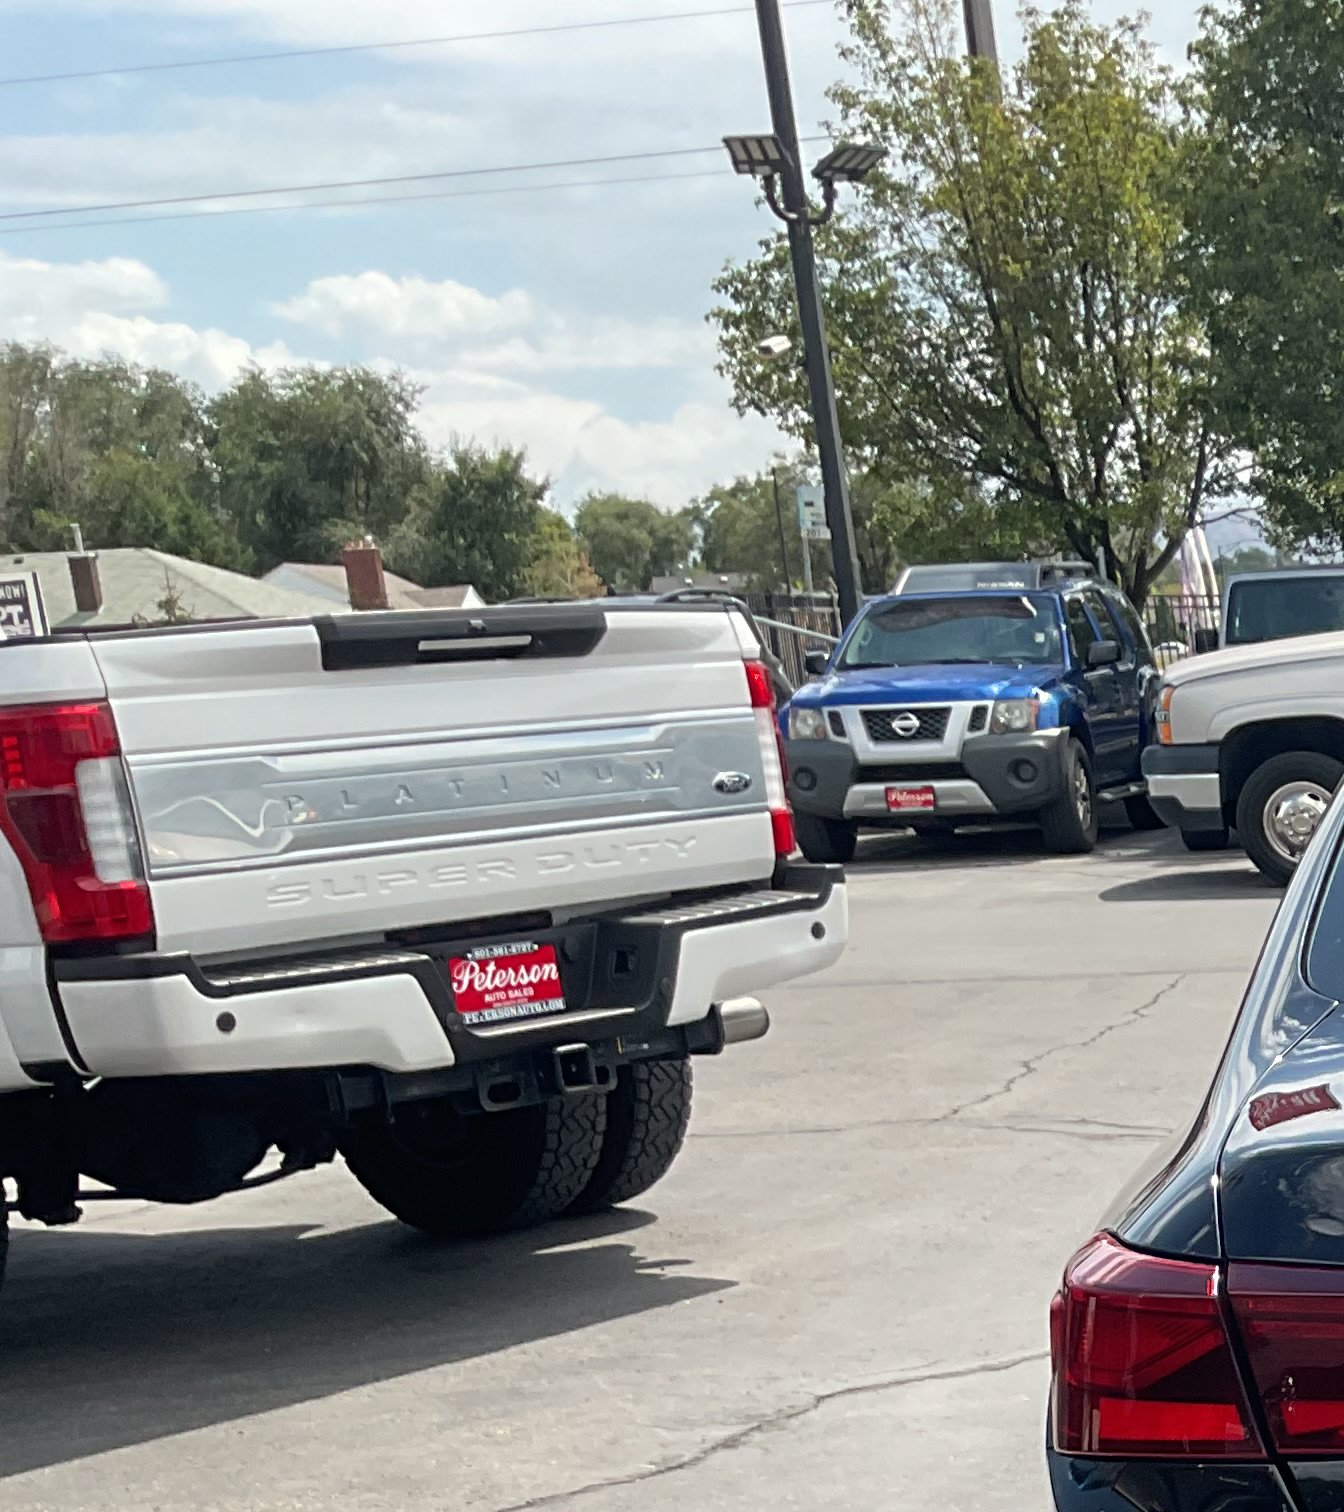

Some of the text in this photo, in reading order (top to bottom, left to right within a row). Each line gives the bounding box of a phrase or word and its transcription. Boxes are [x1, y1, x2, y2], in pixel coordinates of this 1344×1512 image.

[283, 760, 664, 811] PLATINUM
[267, 835, 697, 907] SUPER DUTY
[452, 960, 559, 993] Peterson
